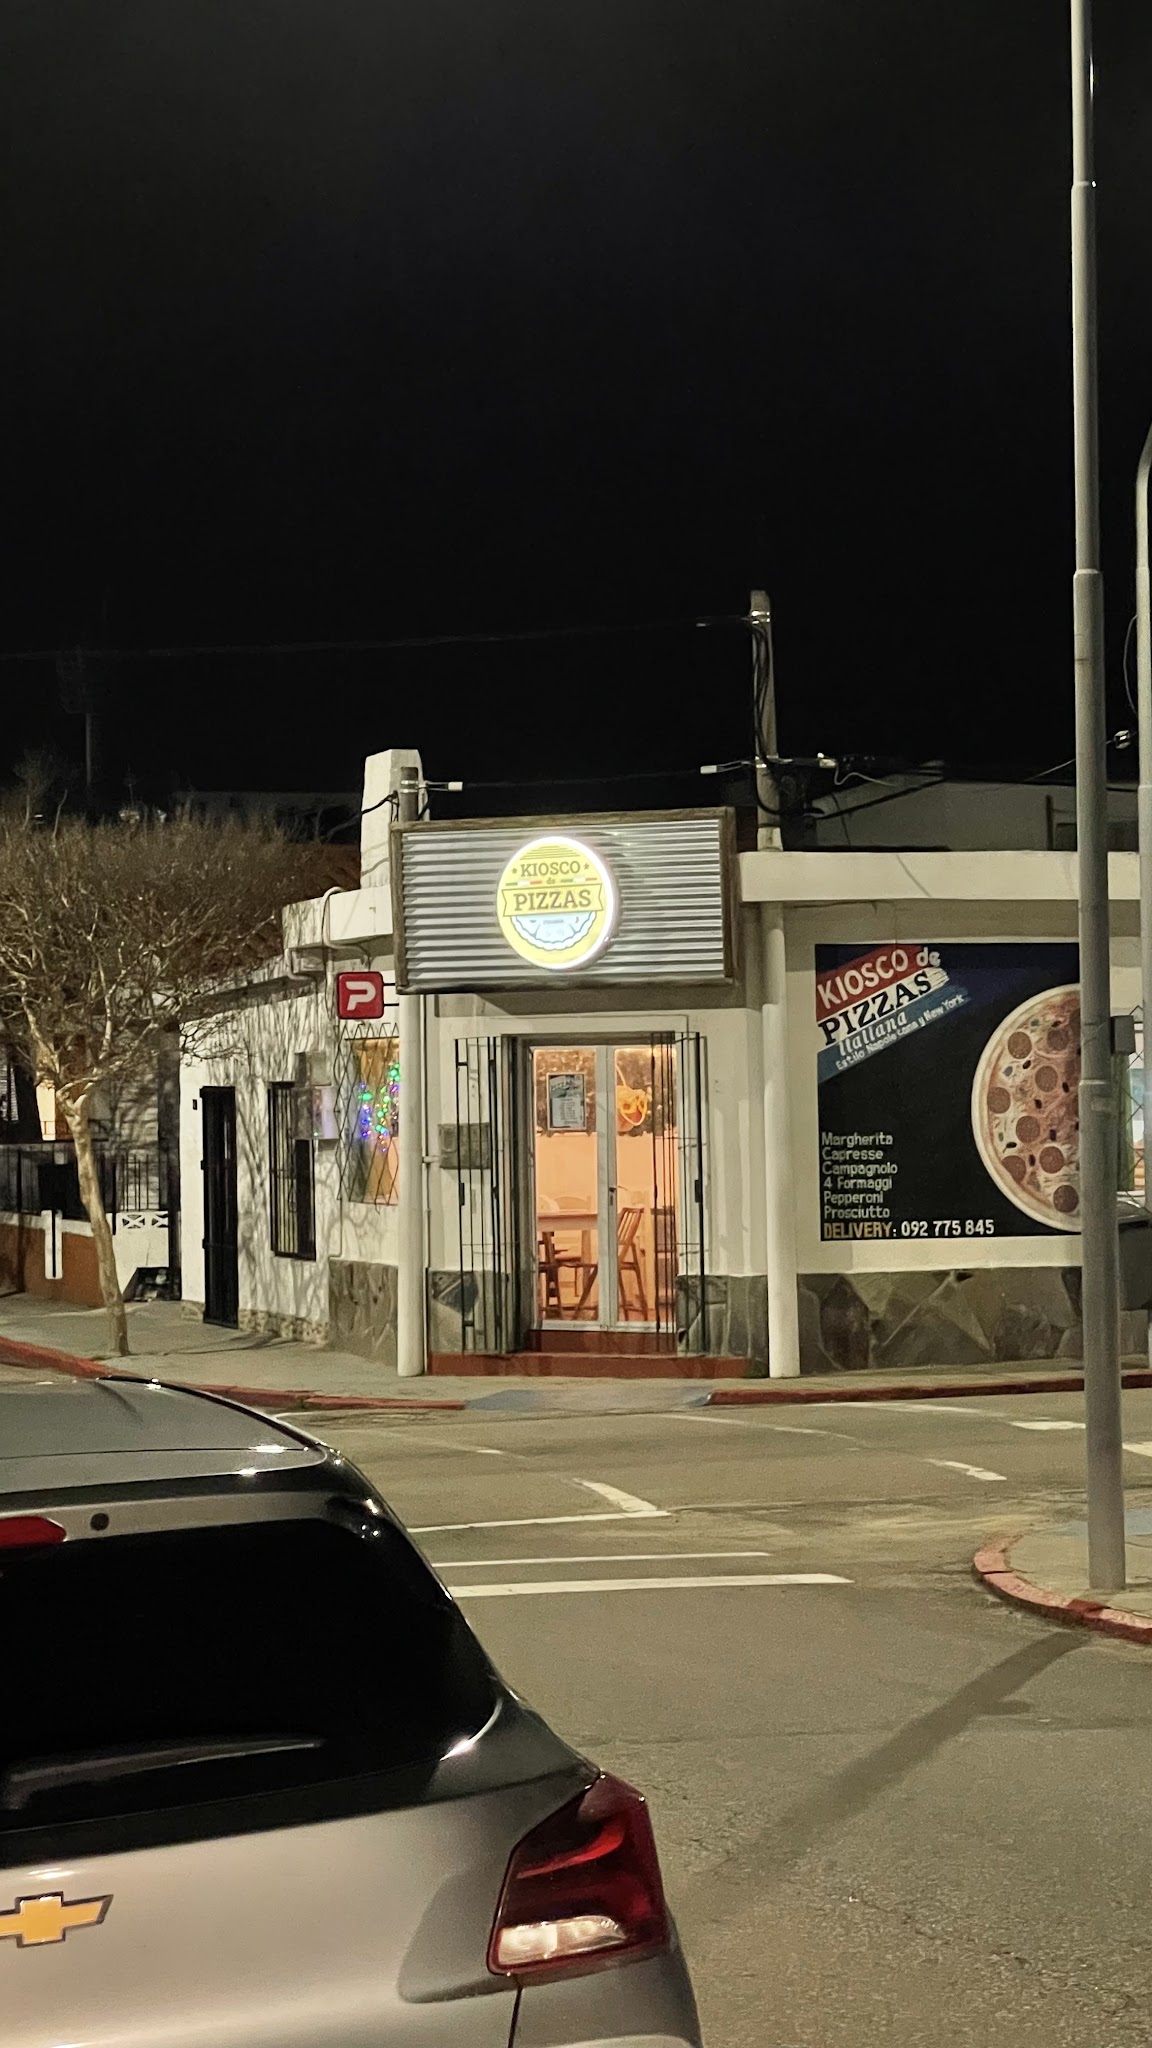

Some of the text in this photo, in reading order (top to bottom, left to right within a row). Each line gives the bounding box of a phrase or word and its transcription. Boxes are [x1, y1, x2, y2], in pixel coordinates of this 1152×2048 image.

[520, 861, 581, 877] KIOSCO
[513, 889, 592, 911] PIZZAS
[817, 946, 941, 1009] KIOSCO de
[818, 970, 932, 1046] PIZZAS
[835, 1049, 865, 1071] Estilo
[925, 1006, 944, 1022] New
[941, 994, 965, 1011] York
[821, 1132, 893, 1148] Margherita
[822, 1148, 884, 1162] Capresse
[822, 1162, 898, 1177] Campagnolo
[823, 1176, 893, 1191] 4 Formaggi
[824, 1191, 884, 1206] Pepperoni
[824, 1205, 890, 1219] Prosciutto
[824, 1219, 995, 1239] DELIVERY: 092 775 845
